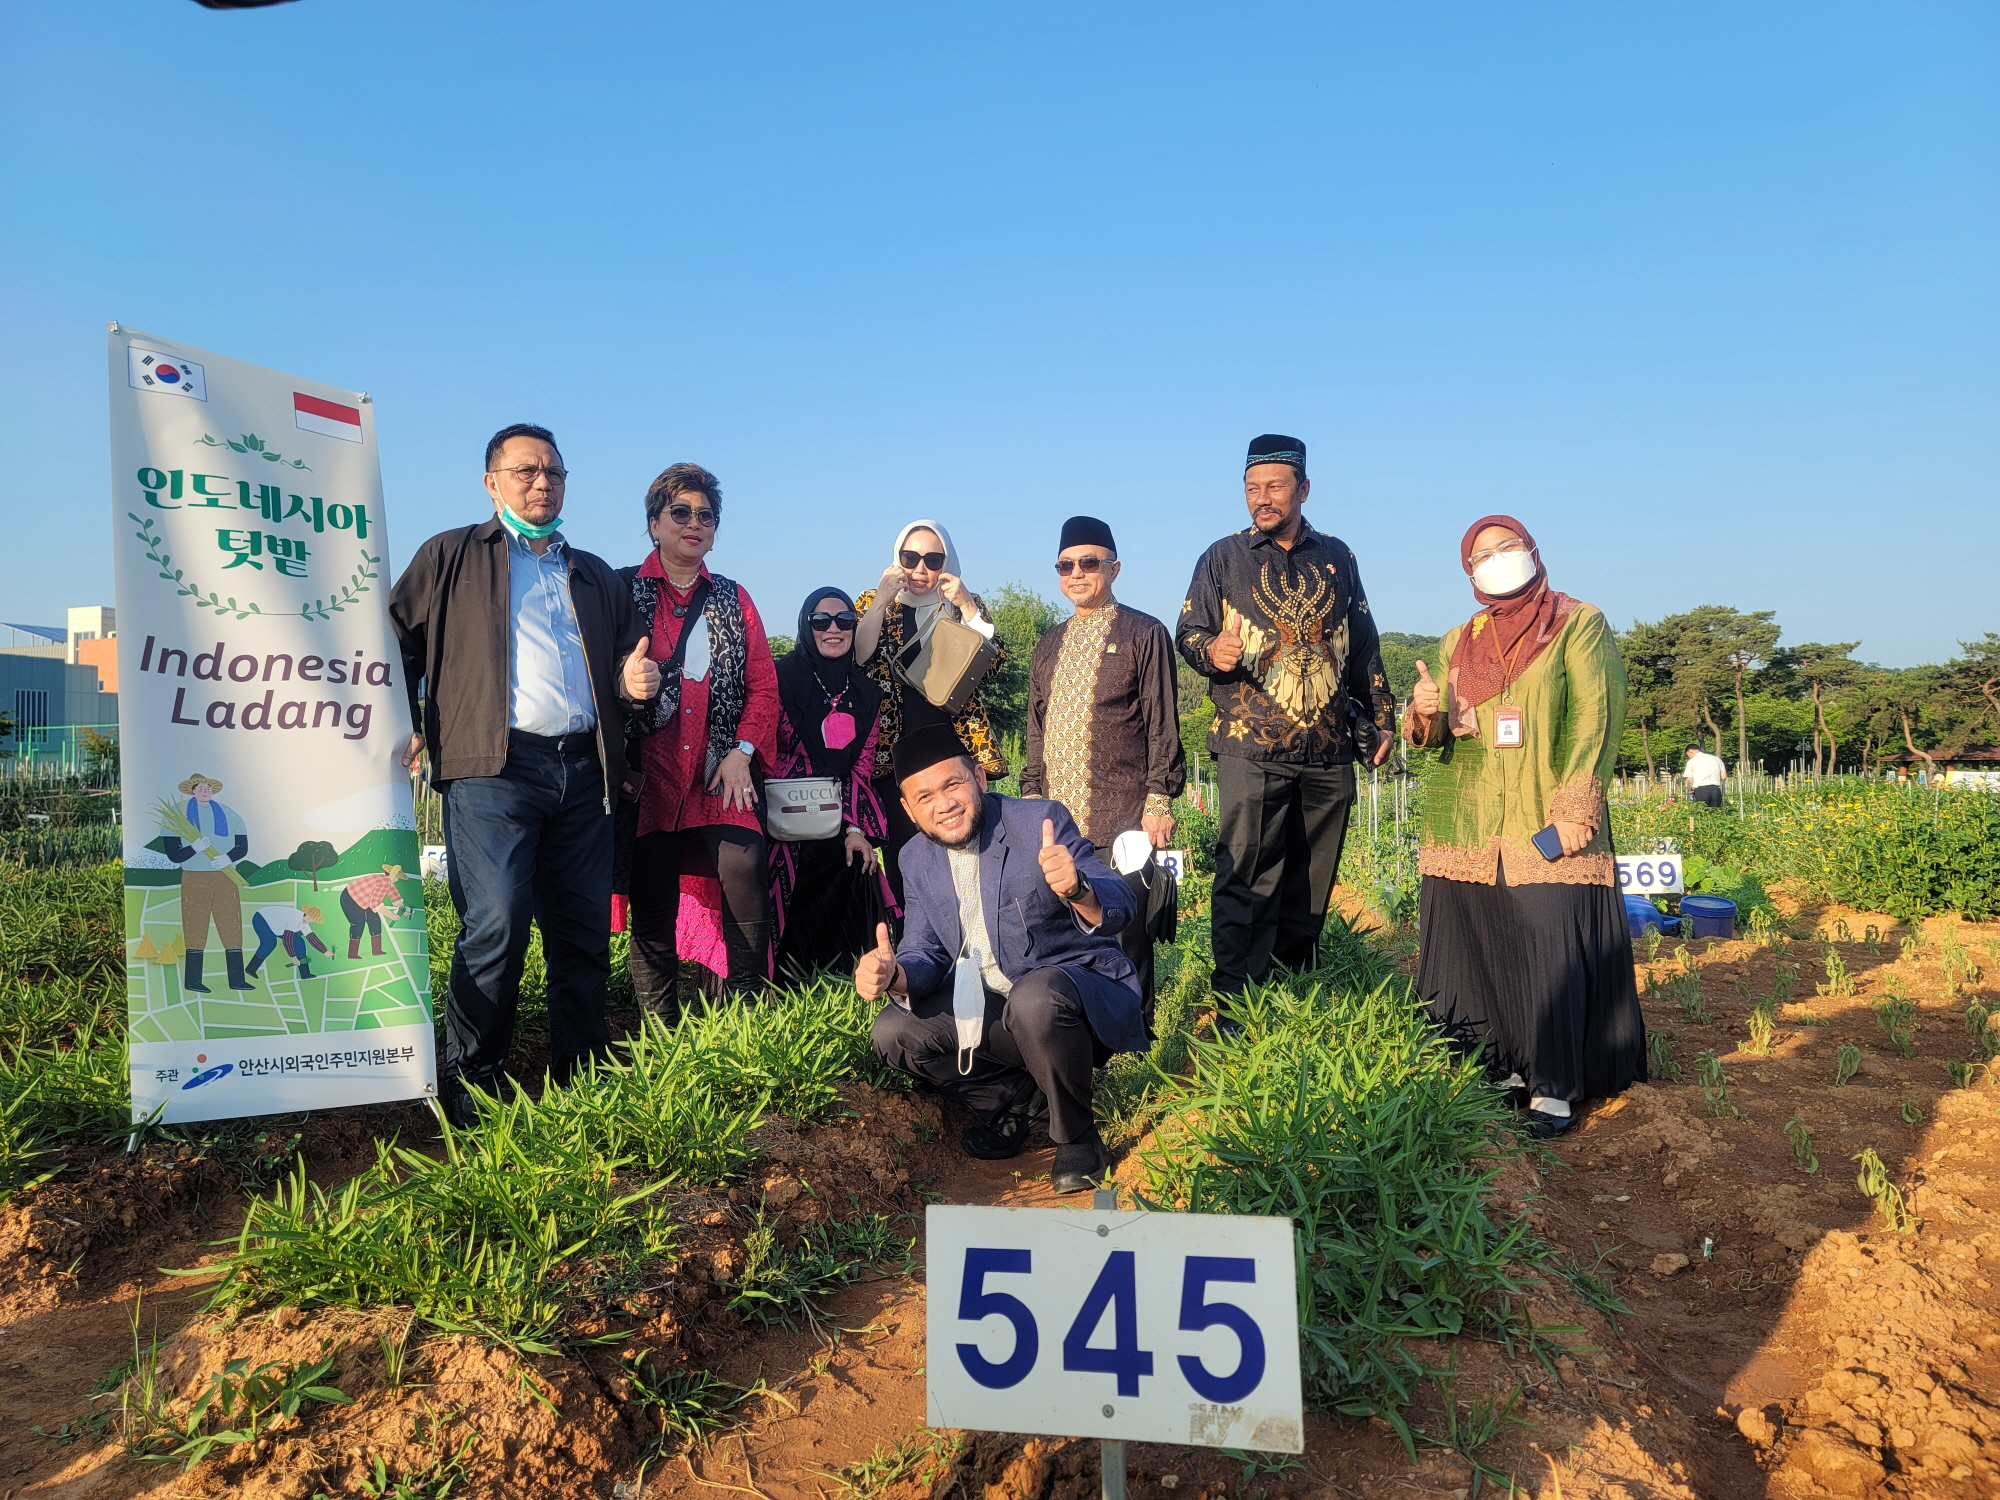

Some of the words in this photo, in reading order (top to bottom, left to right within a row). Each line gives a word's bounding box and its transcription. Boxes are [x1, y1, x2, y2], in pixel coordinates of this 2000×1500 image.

[137, 467, 373, 539] 인도네시아
[215, 529, 312, 578] 텃밭
[140, 635, 393, 687] Indonesia
[171, 687, 373, 740] Ladang
[787, 788, 833, 801] GUCCI
[1617, 861, 1677, 888] 569
[155, 1069, 179, 1083] 주관
[238, 1046, 415, 1077] 안산시외국인주민지원본부
[956, 1247, 1266, 1404] 545
